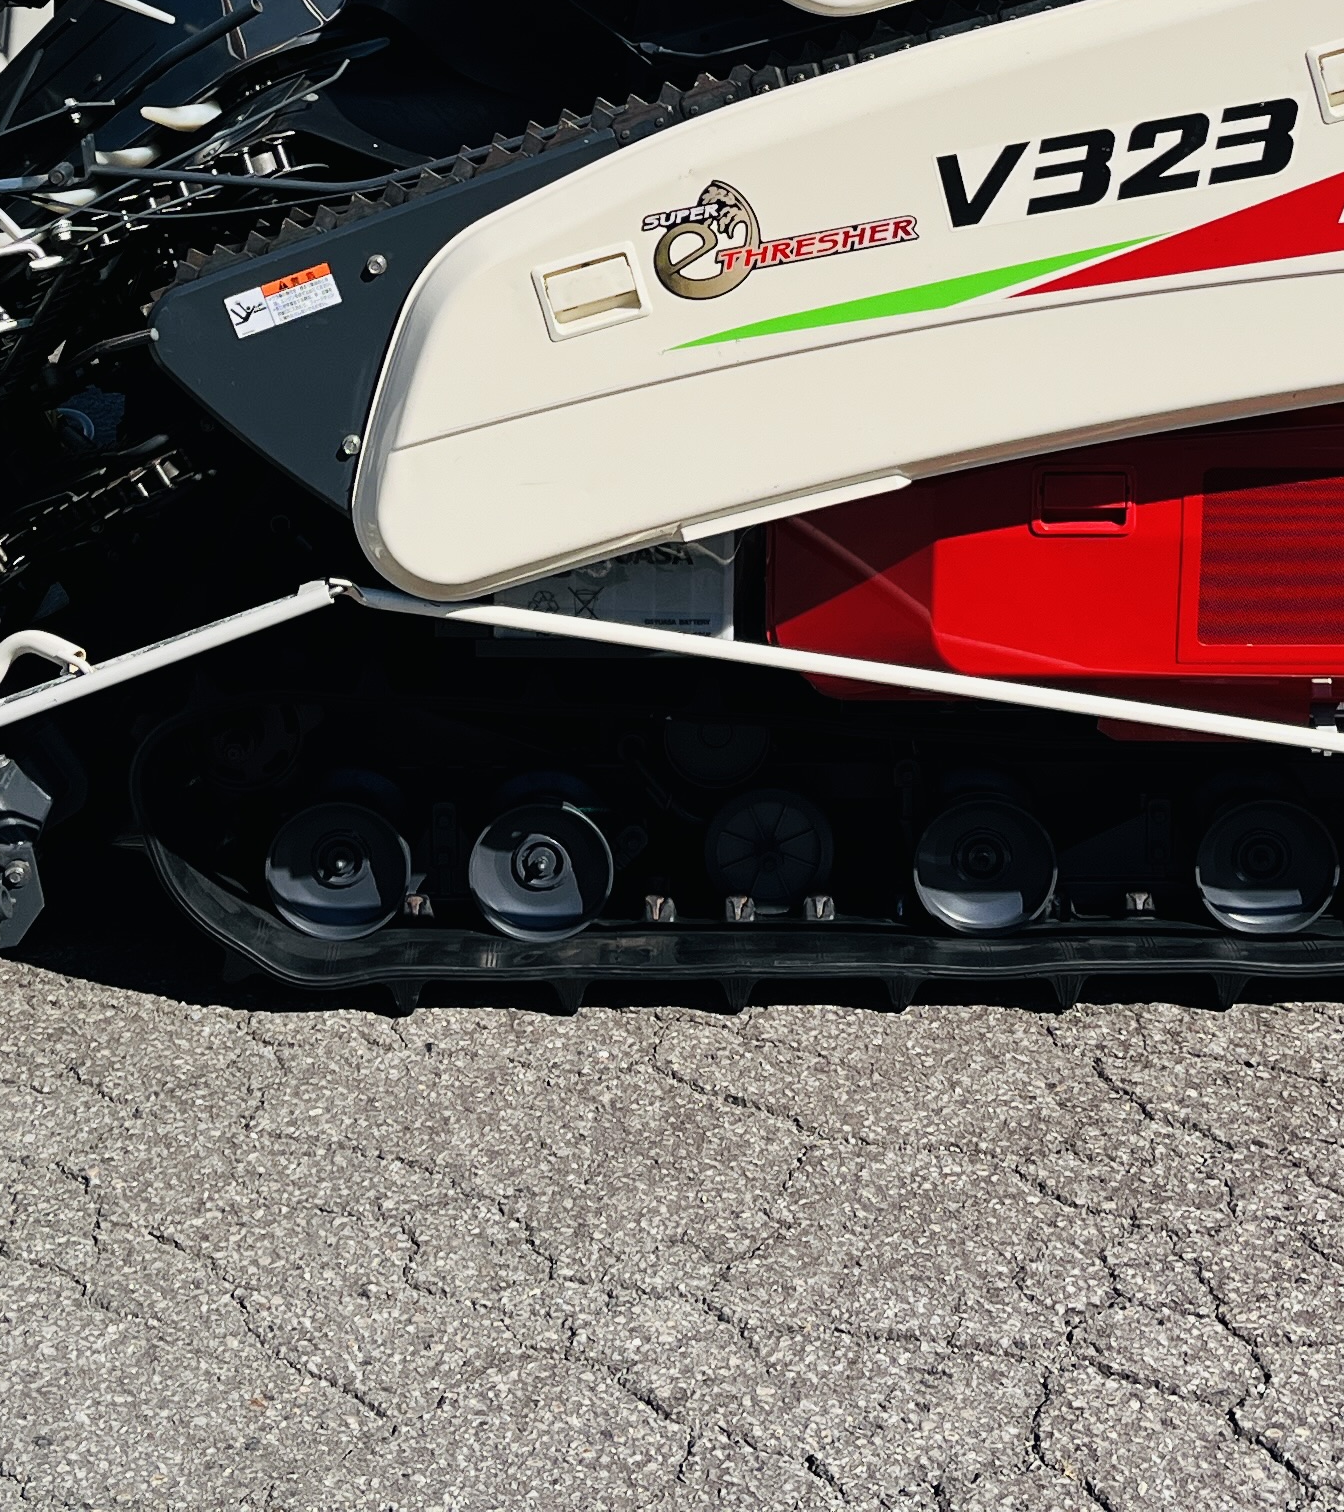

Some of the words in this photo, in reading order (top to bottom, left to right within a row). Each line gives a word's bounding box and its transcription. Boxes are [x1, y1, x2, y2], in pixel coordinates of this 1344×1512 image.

[936, 97, 1299, 229] V323
[643, 203, 719, 231] SUPER
[719, 217, 918, 272] THRESHER
